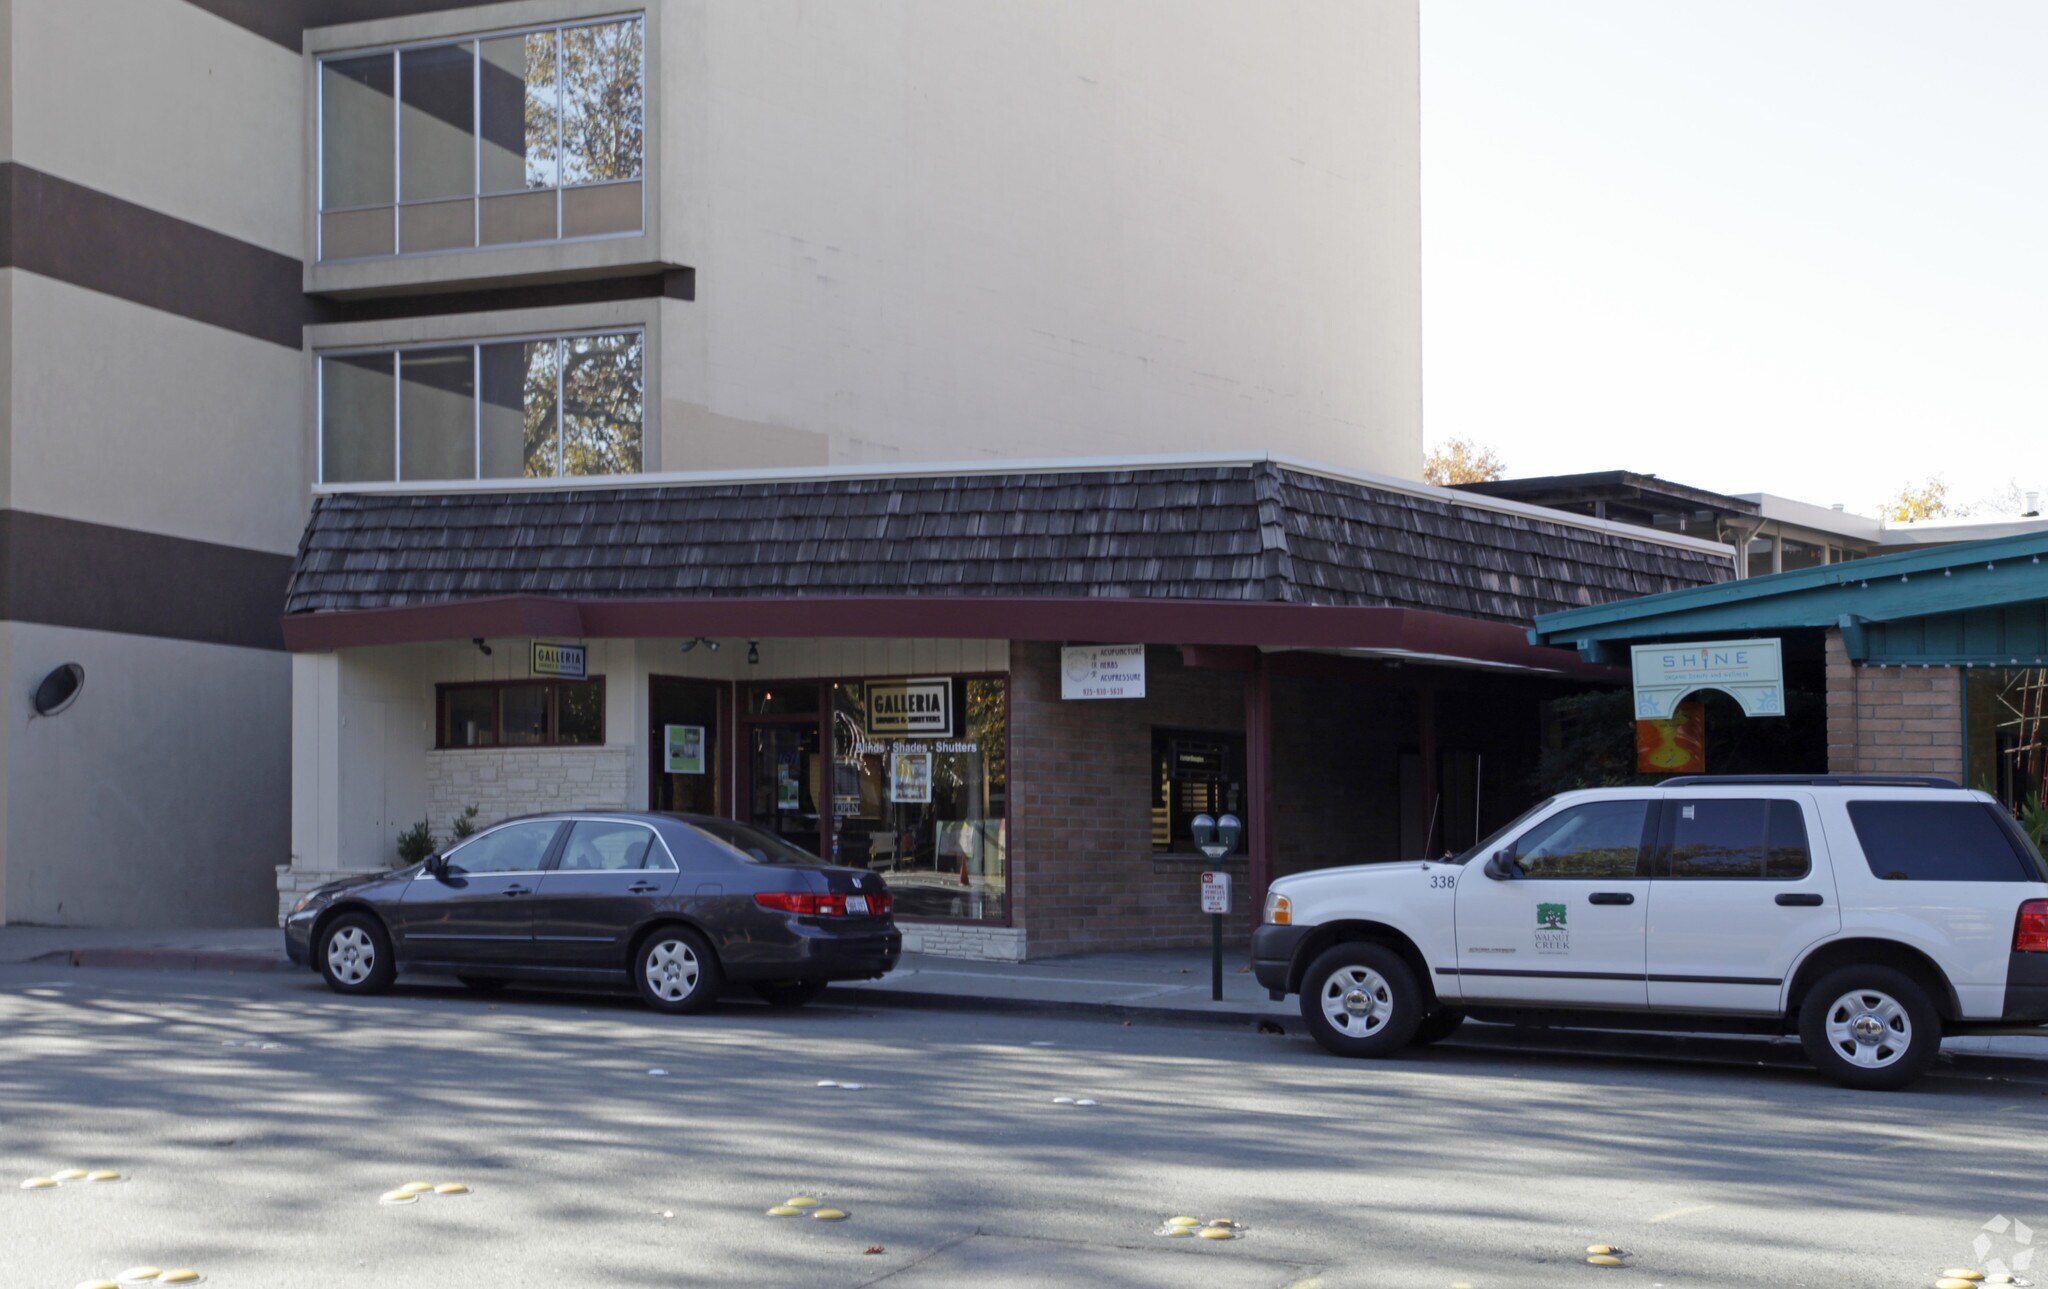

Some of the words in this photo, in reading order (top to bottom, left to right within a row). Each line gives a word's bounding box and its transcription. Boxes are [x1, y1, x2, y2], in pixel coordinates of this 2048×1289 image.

[538, 649, 581, 664] GALLERIA
[1100, 647, 1142, 656] ACUPUNCTURE
[1663, 649, 1748, 669] SHINE
[1100, 661, 1119, 669] HERBS
[1100, 673, 1141, 682] ACUPRESSURE
[873, 693, 942, 714] GALLERIA
[856, 741, 885, 753] Blinds
[892, 741, 929, 753] Shades
[935, 741, 978, 753] Shutters
[835, 803, 859, 813] OPEN
[1430, 875, 1456, 889] 338
[1534, 934, 1570, 942] WALNUT
[1534, 942, 1571, 950] CREEK
